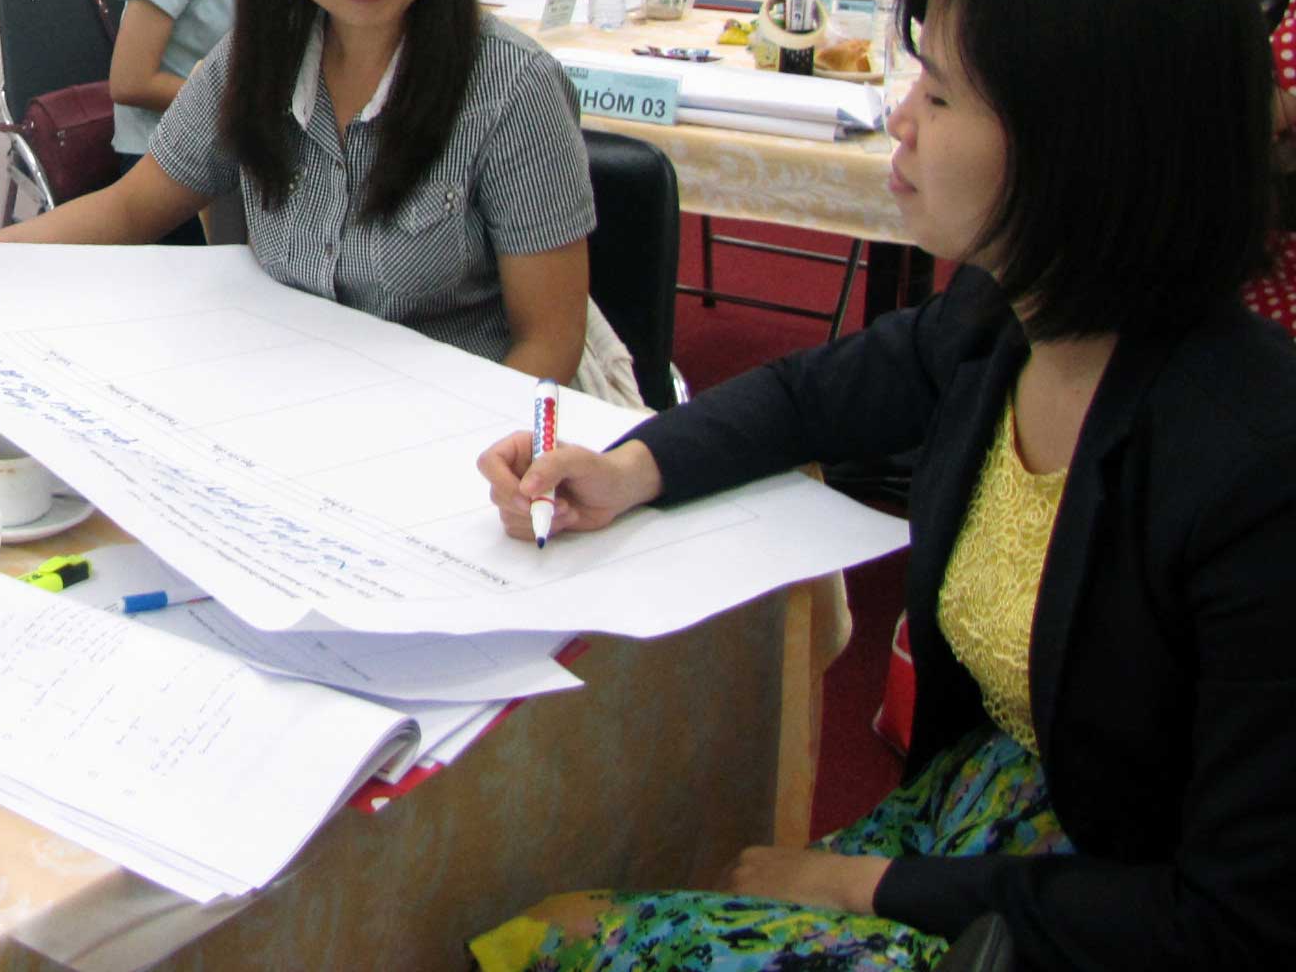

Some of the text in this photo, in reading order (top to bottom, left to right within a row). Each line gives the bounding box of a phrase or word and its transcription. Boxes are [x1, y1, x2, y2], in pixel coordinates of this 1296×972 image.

[577, 88, 666, 118] HÓM 03
[534, 398, 542, 453] EBOARD
